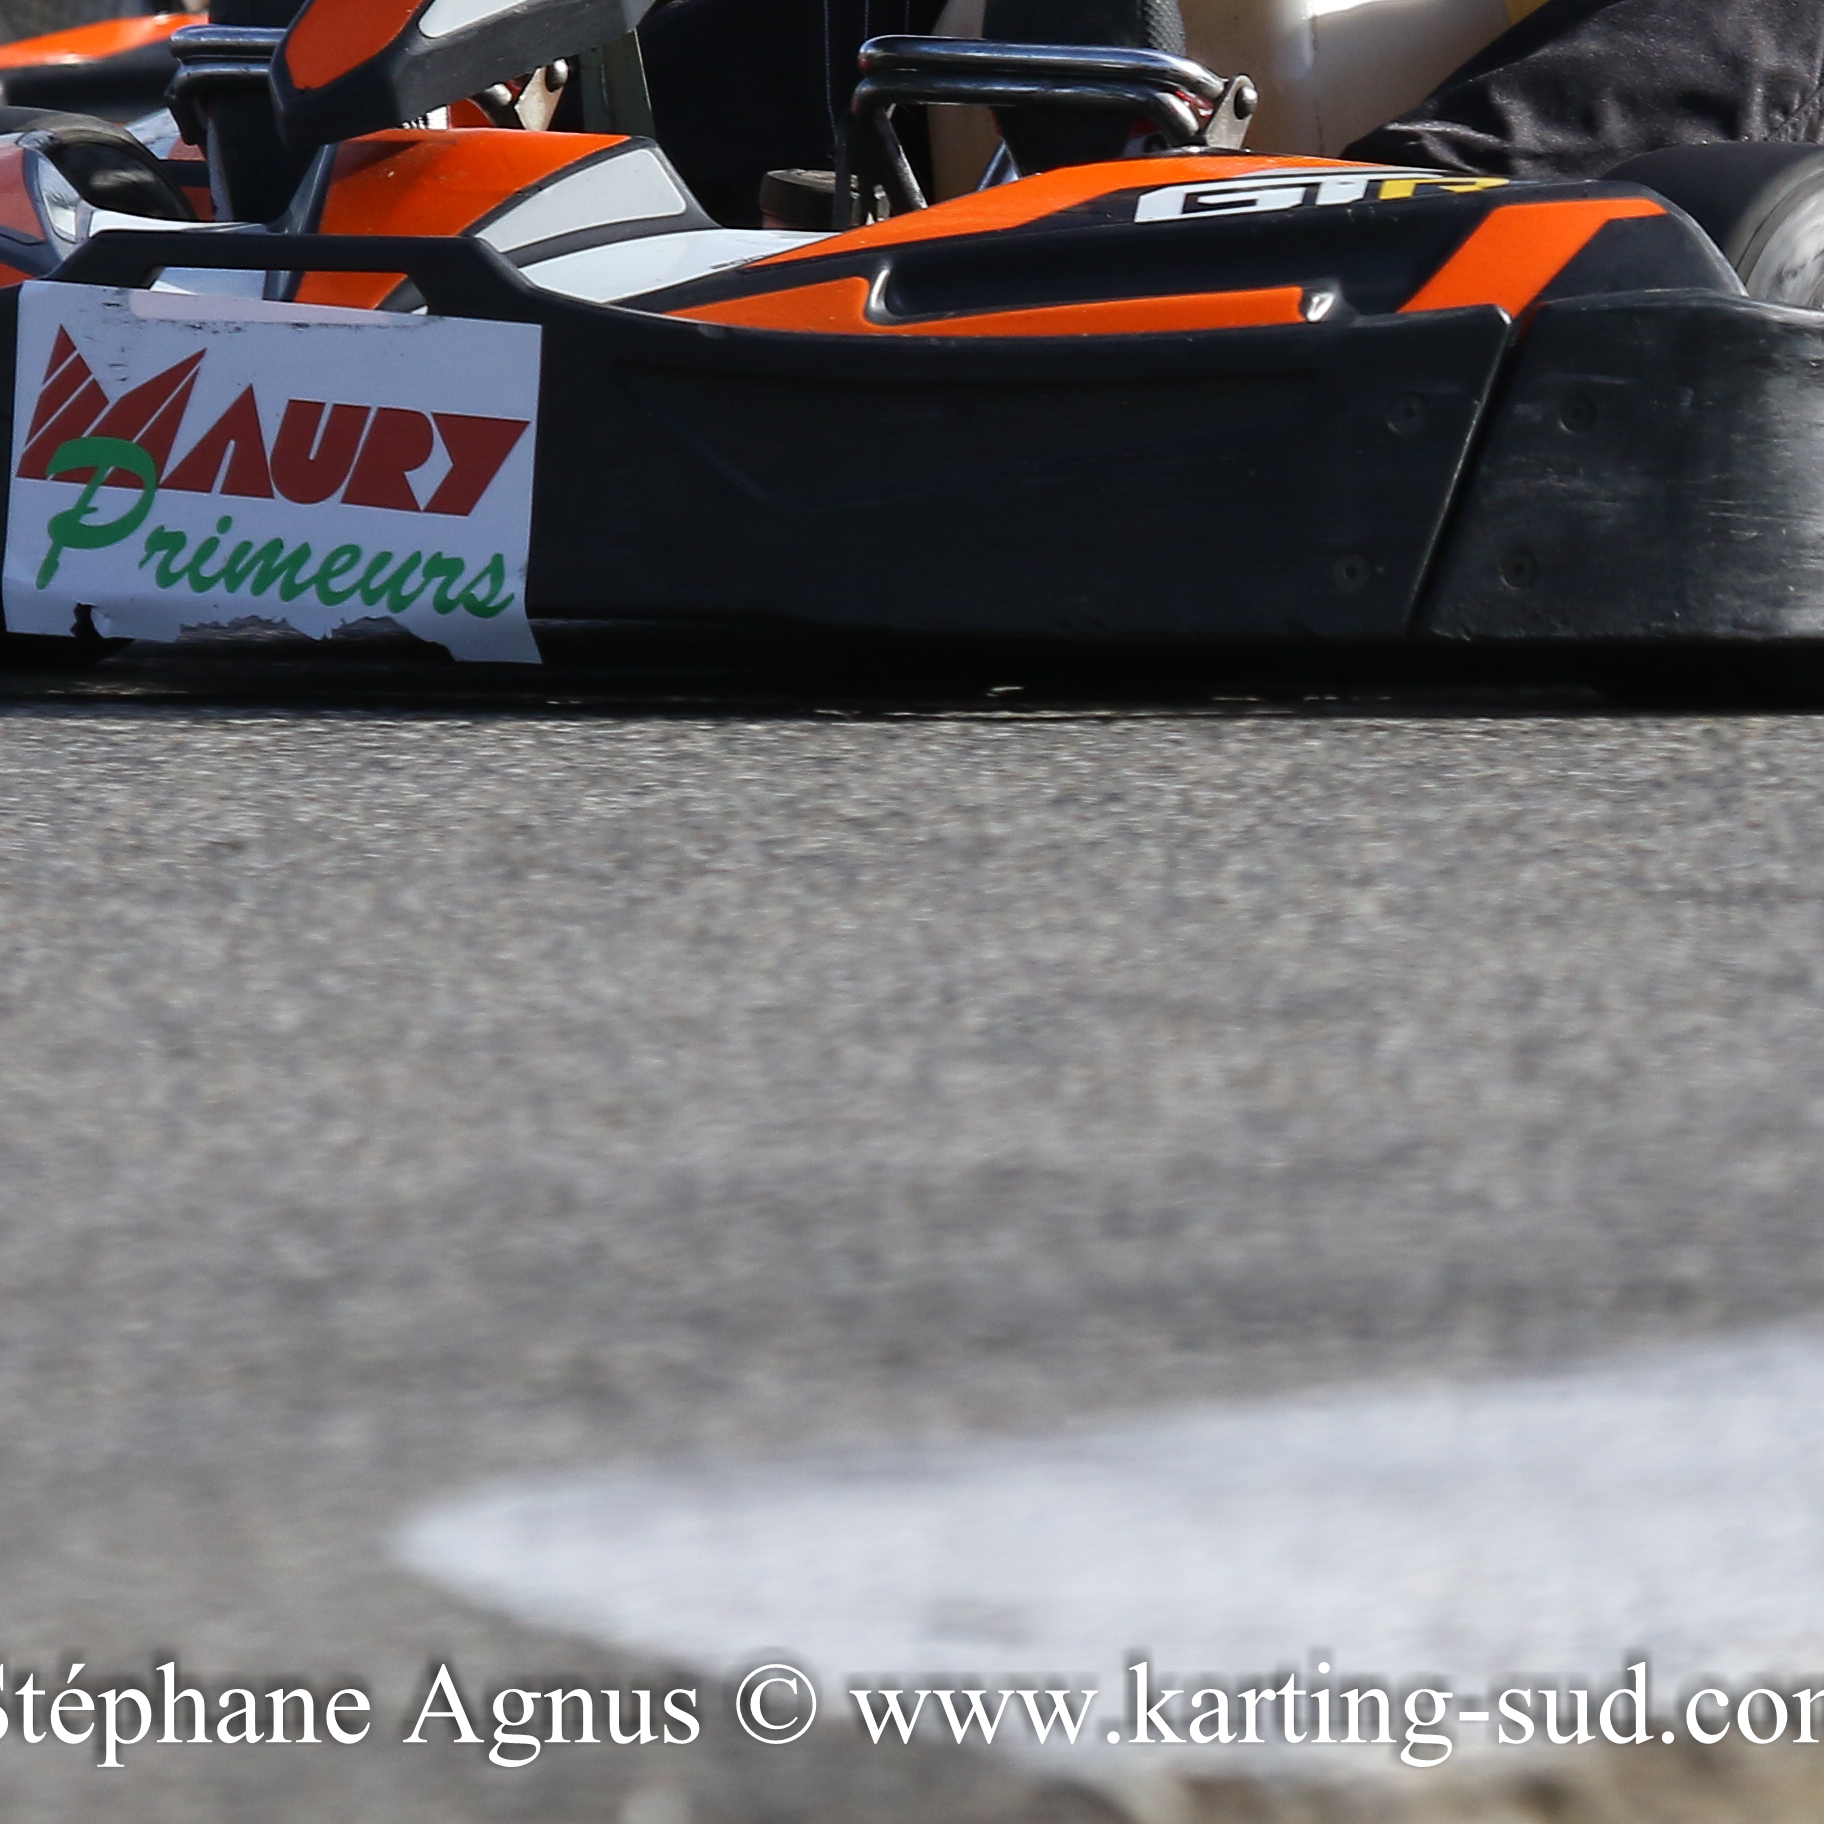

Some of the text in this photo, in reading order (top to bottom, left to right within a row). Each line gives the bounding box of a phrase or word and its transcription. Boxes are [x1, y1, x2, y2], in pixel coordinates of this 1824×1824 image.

[1134, 174, 1510, 223] GTR
[15, 323, 531, 517] MAURY
[35, 435, 516, 618] Primeurs
